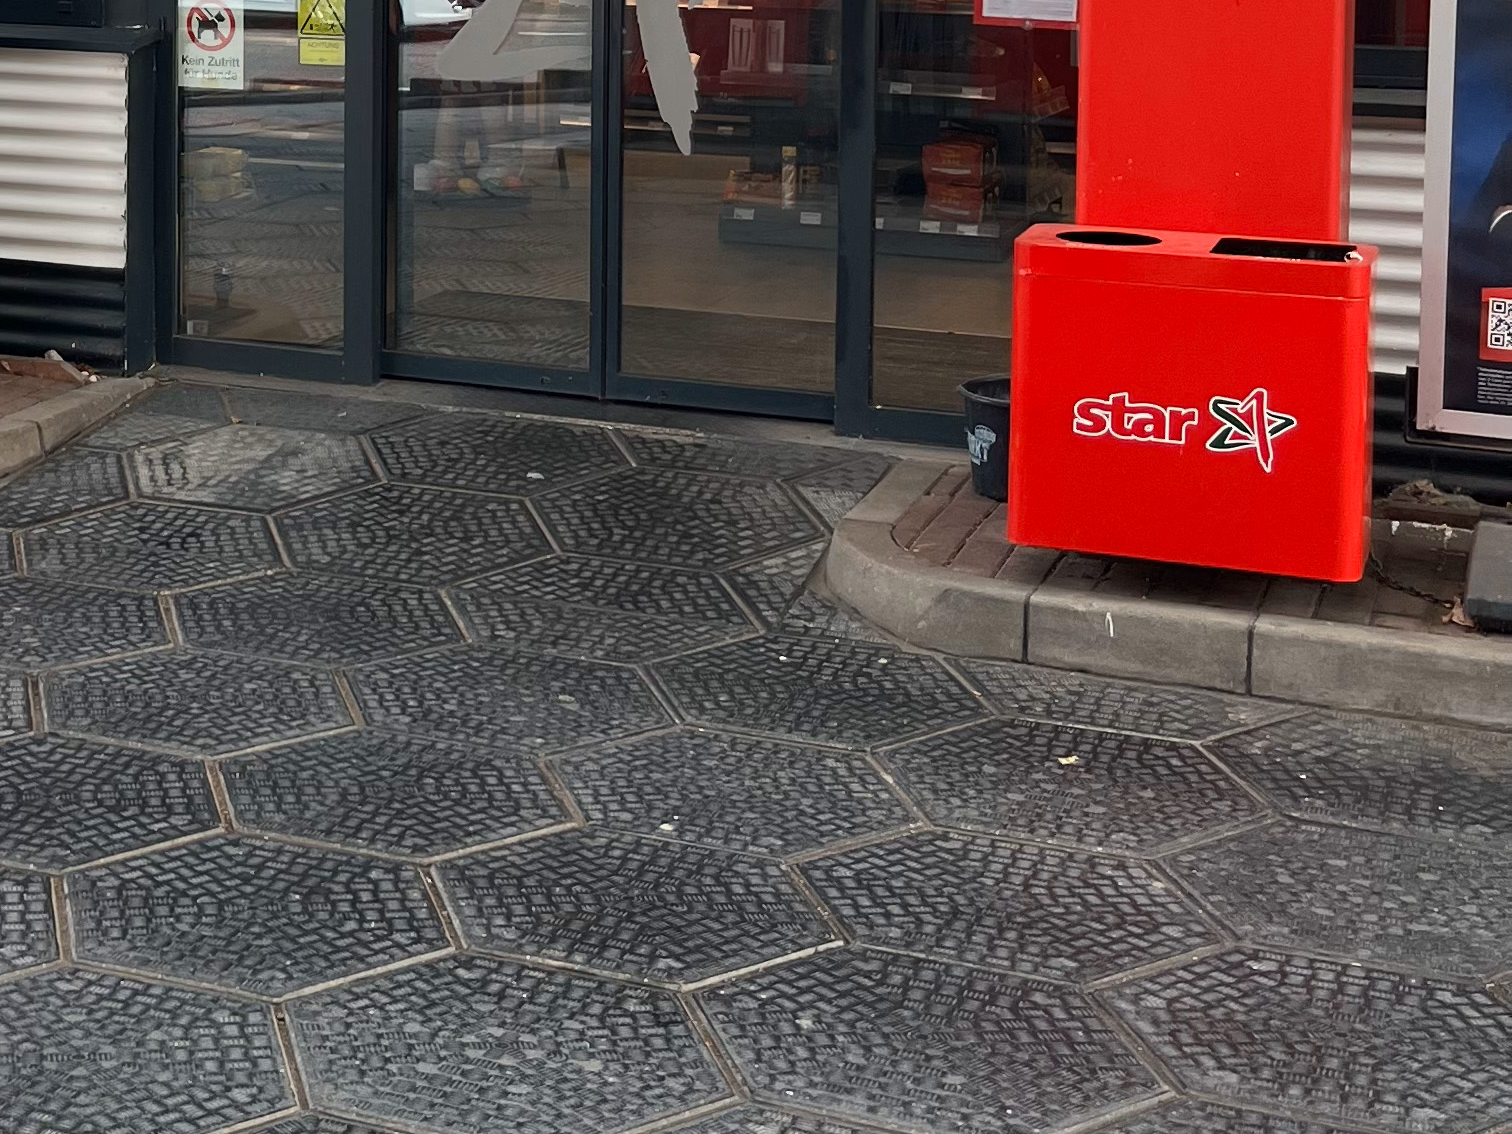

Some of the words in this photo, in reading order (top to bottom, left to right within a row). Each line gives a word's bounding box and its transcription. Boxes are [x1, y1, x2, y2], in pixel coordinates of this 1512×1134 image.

[181, 54, 205, 66] Kein
[208, 55, 240, 68] Zutritt
[1073, 392, 1198, 445] star
